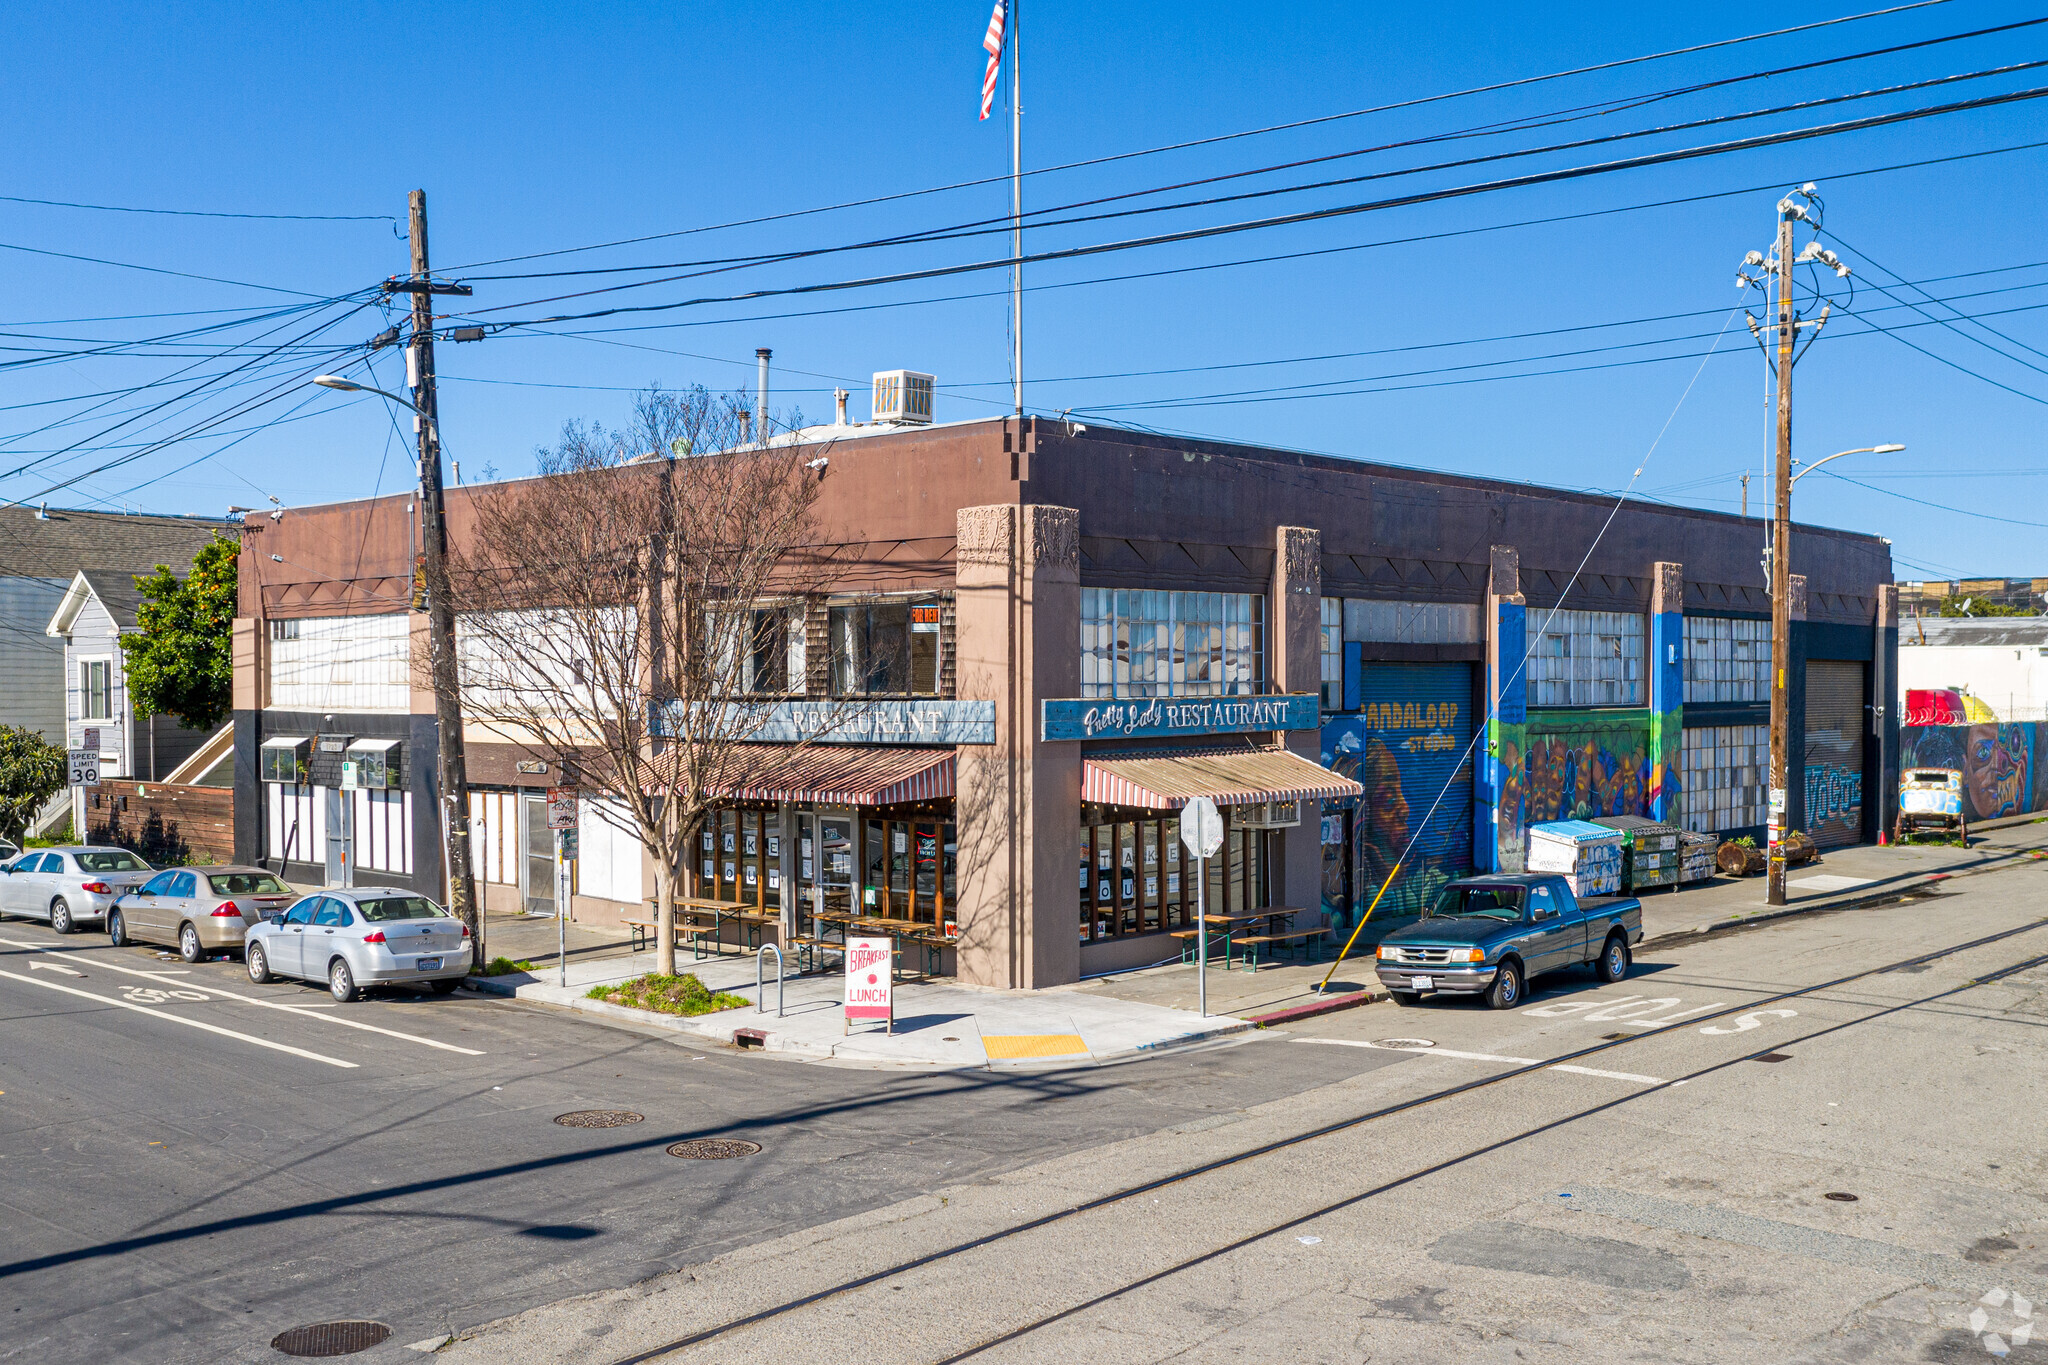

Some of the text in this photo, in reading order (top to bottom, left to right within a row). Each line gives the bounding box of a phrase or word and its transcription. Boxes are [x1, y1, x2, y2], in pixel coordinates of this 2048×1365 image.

[912, 608, 924, 623] FOR
[792, 711, 943, 735] RESTAURANT
[1083, 698, 1290, 736] Pretty Lady RESTAURANT
[1408, 734, 1456, 753] STUDIO
[71, 753, 97, 761] SPEED
[73, 760, 94, 768] LIMIT
[72, 768, 97, 783] 30
[704, 836, 778, 854] TAKE
[1100, 847, 1177, 867] TAKE
[1101, 883, 1156, 898] OUT
[850, 949, 889, 973] BREAKFAST
[849, 988, 887, 1002] LUNCH
